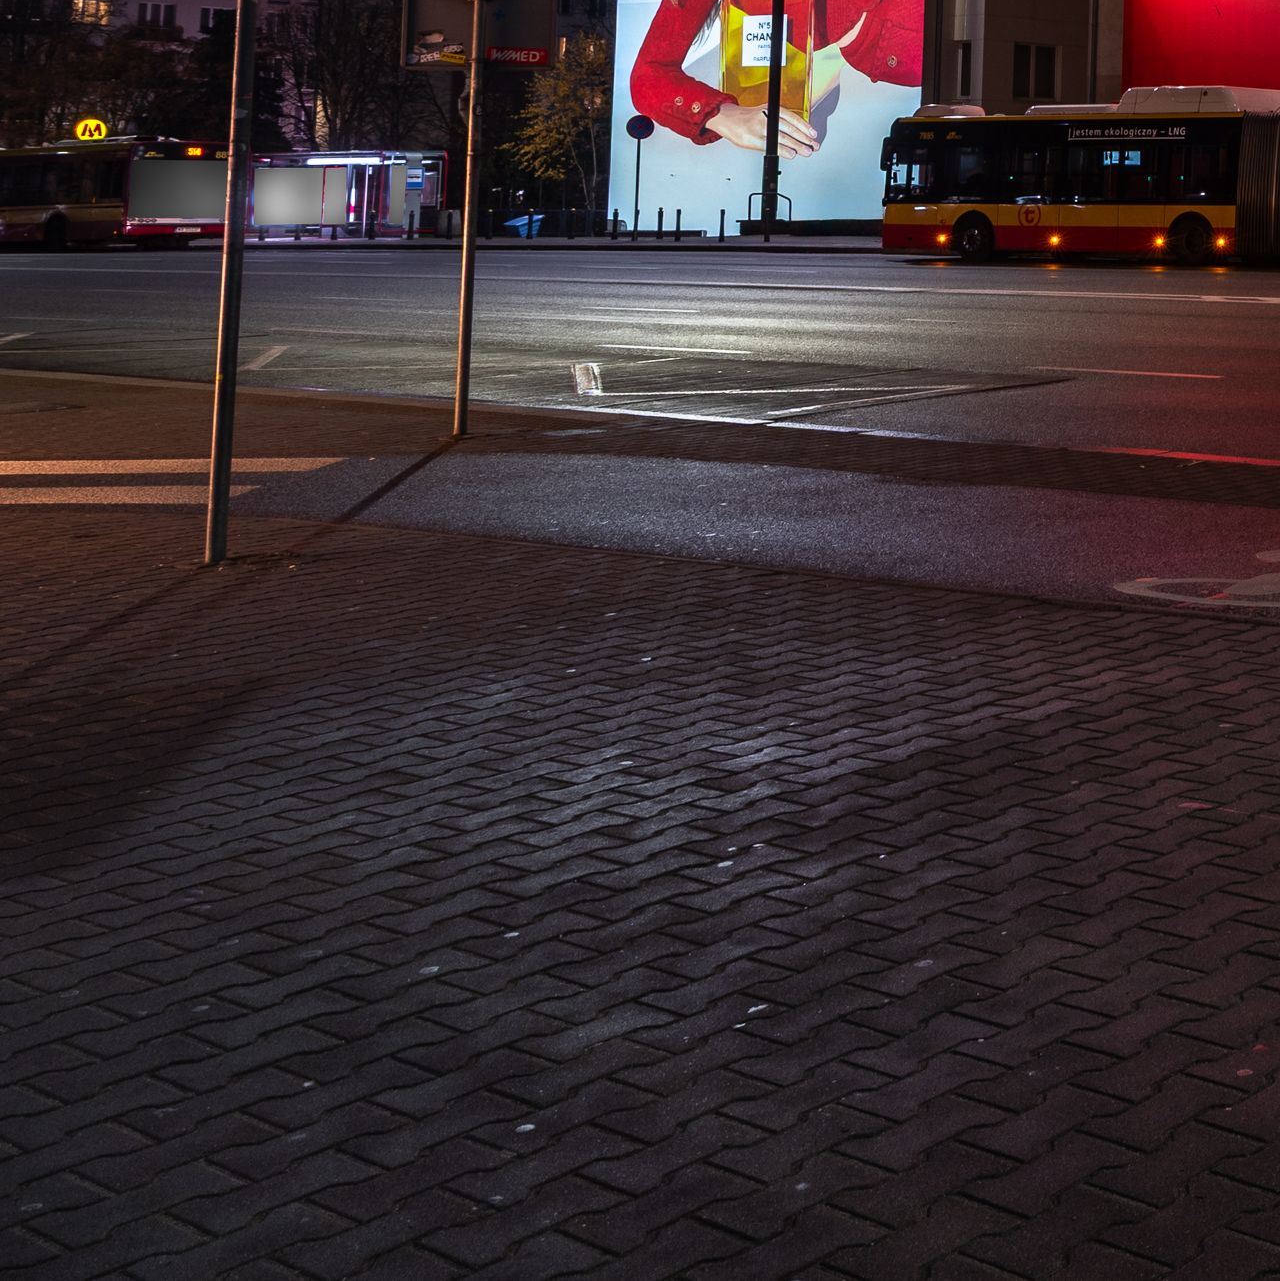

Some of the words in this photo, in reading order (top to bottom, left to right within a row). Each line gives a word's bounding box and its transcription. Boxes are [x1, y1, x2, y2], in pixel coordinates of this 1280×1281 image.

[746, 32, 772, 41] CHAN
[1072, 127, 1102, 138] jestem
[1104, 126, 1158, 138] ekologiczny
[1168, 126, 1186, 136] LNG
